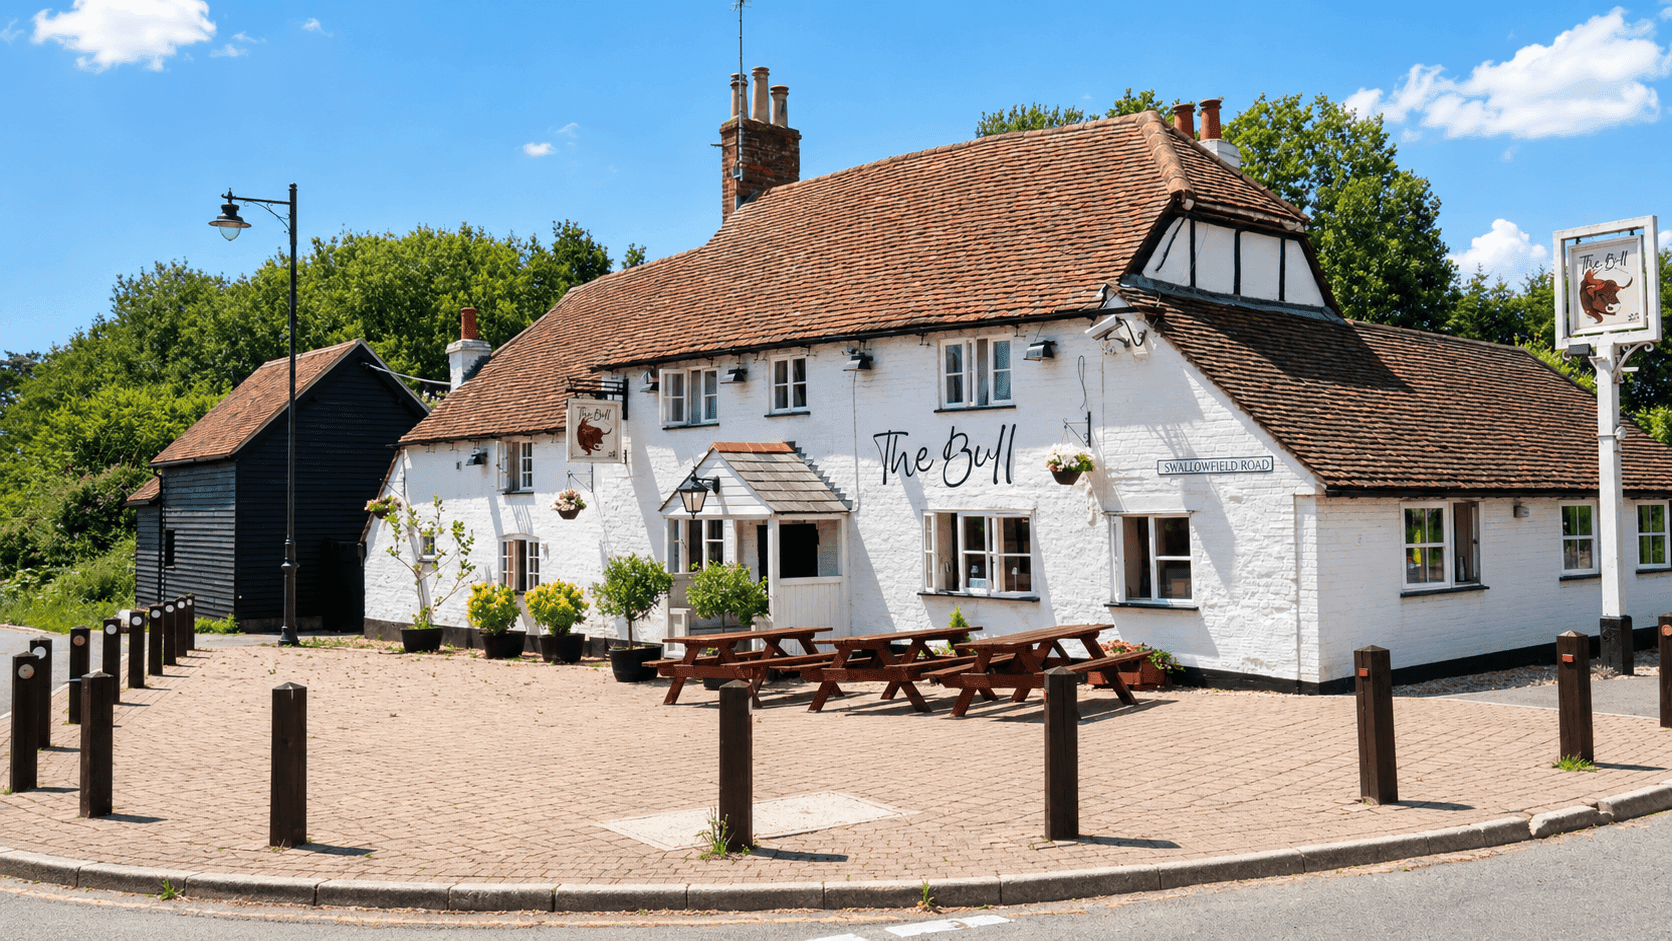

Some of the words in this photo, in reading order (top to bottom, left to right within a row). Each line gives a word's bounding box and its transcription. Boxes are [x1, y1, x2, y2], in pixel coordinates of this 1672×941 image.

[1579, 254, 1602, 275] The
[1605, 250, 1628, 271] Bull
[577, 406, 593, 420] The
[594, 408, 611, 421] Bull
[873, 430, 934, 485] The
[943, 424, 1016, 488] Bull
[1164, 460, 1238, 473] SWALLOWFIELD
[1241, 458, 1270, 471] ROAD
